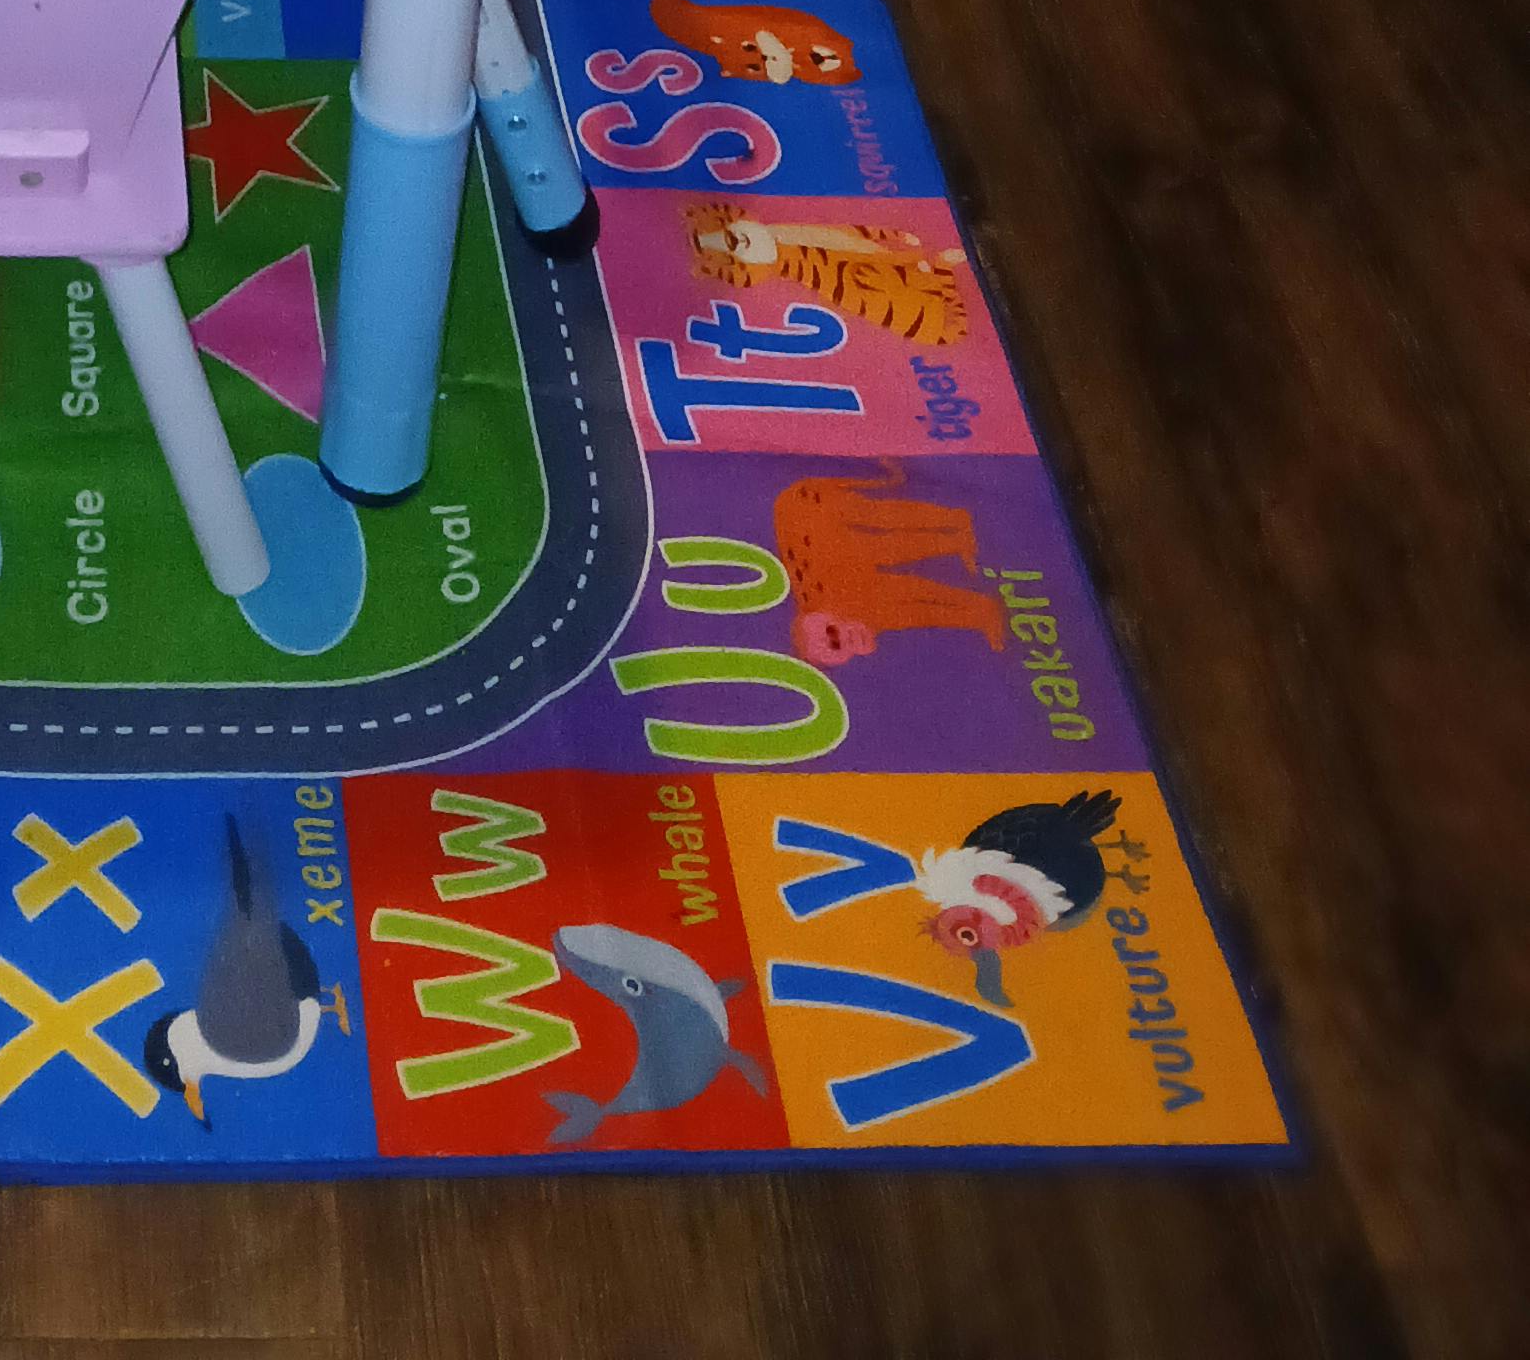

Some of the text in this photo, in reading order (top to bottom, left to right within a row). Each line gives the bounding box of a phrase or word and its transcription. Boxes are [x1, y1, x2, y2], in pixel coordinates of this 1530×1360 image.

[576, 49, 782, 185] Ss
[831, 88, 901, 196] squirrel
[61, 280, 99, 418] Square
[637, 300, 864, 446] Tt
[908, 355, 981, 442] tiger
[66, 486, 108, 625] Circle
[431, 503, 481, 605] Oval
[609, 536, 849, 765] Uu
[983, 567, 1096, 742] uakari
[294, 783, 346, 927] xeme
[648, 783, 718, 926] whale
[369, 788, 581, 1101] Ww
[766, 815, 1037, 1132] Vv
[1105, 905, 1206, 1113] vulture
